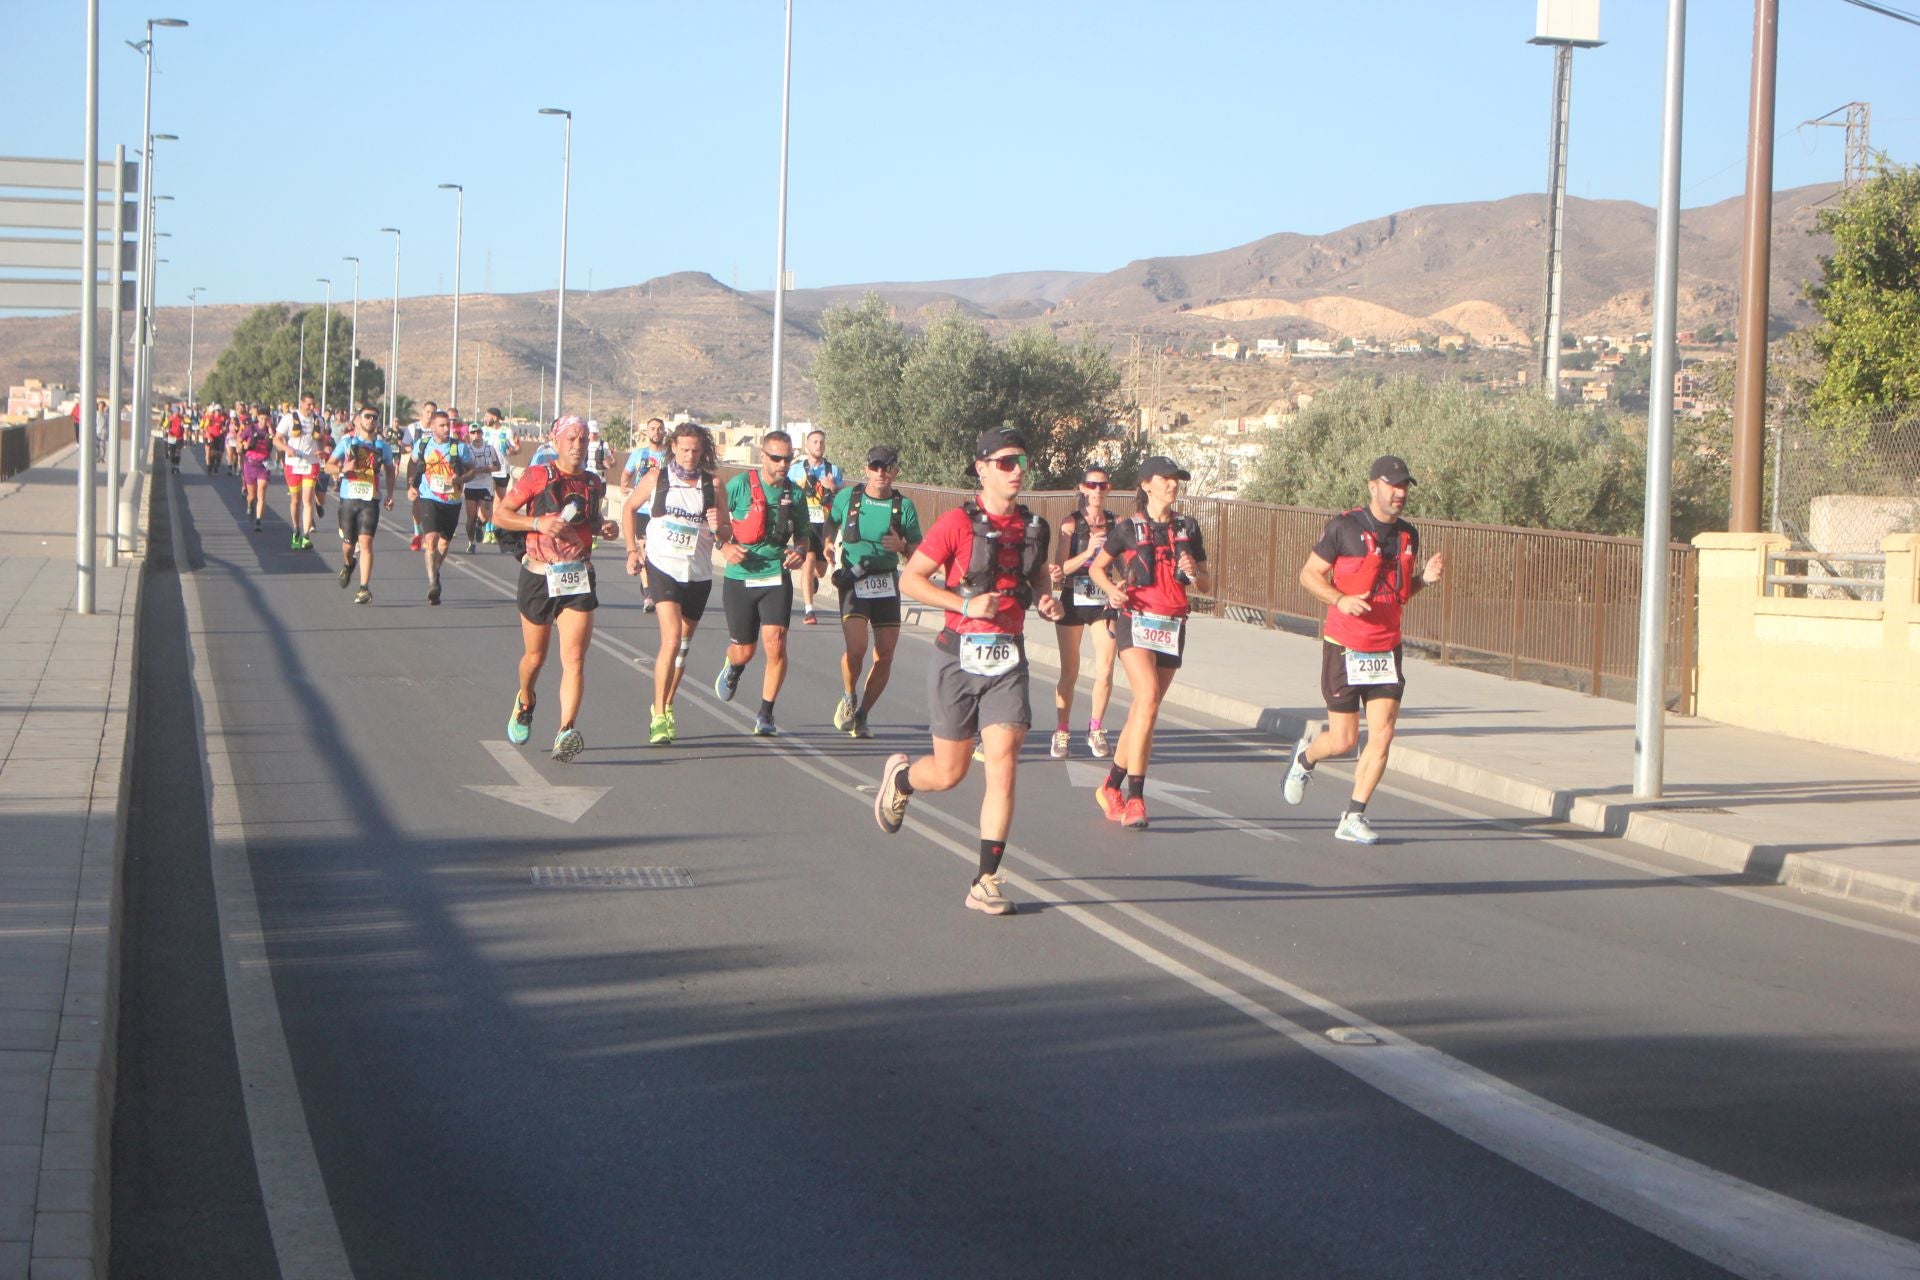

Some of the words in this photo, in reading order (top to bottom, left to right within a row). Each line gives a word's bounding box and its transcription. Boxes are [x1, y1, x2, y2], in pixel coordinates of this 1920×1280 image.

[666, 530, 691, 546] 2331
[560, 572, 580, 584] 495
[864, 578, 888, 591] 1036
[1142, 627, 1173, 645] 3026
[975, 644, 1010, 661] 1766
[1358, 658, 1389, 672] 2302
